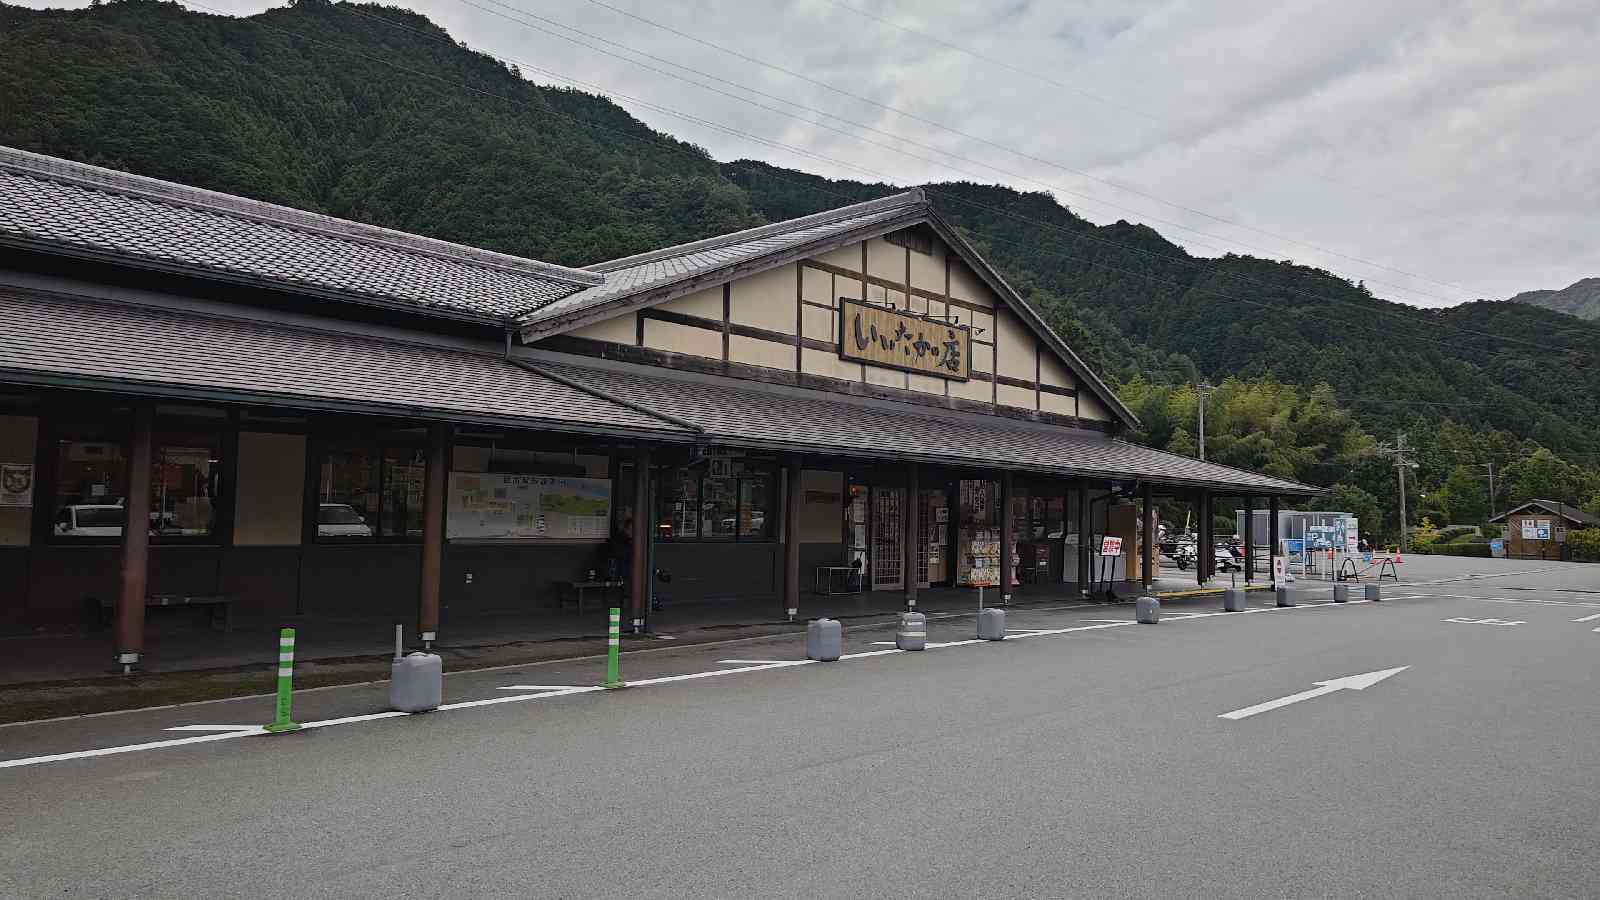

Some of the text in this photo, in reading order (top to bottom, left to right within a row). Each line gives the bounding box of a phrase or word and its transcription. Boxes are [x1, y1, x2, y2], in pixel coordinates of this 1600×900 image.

[855, 312, 960, 373] いいたかの店
